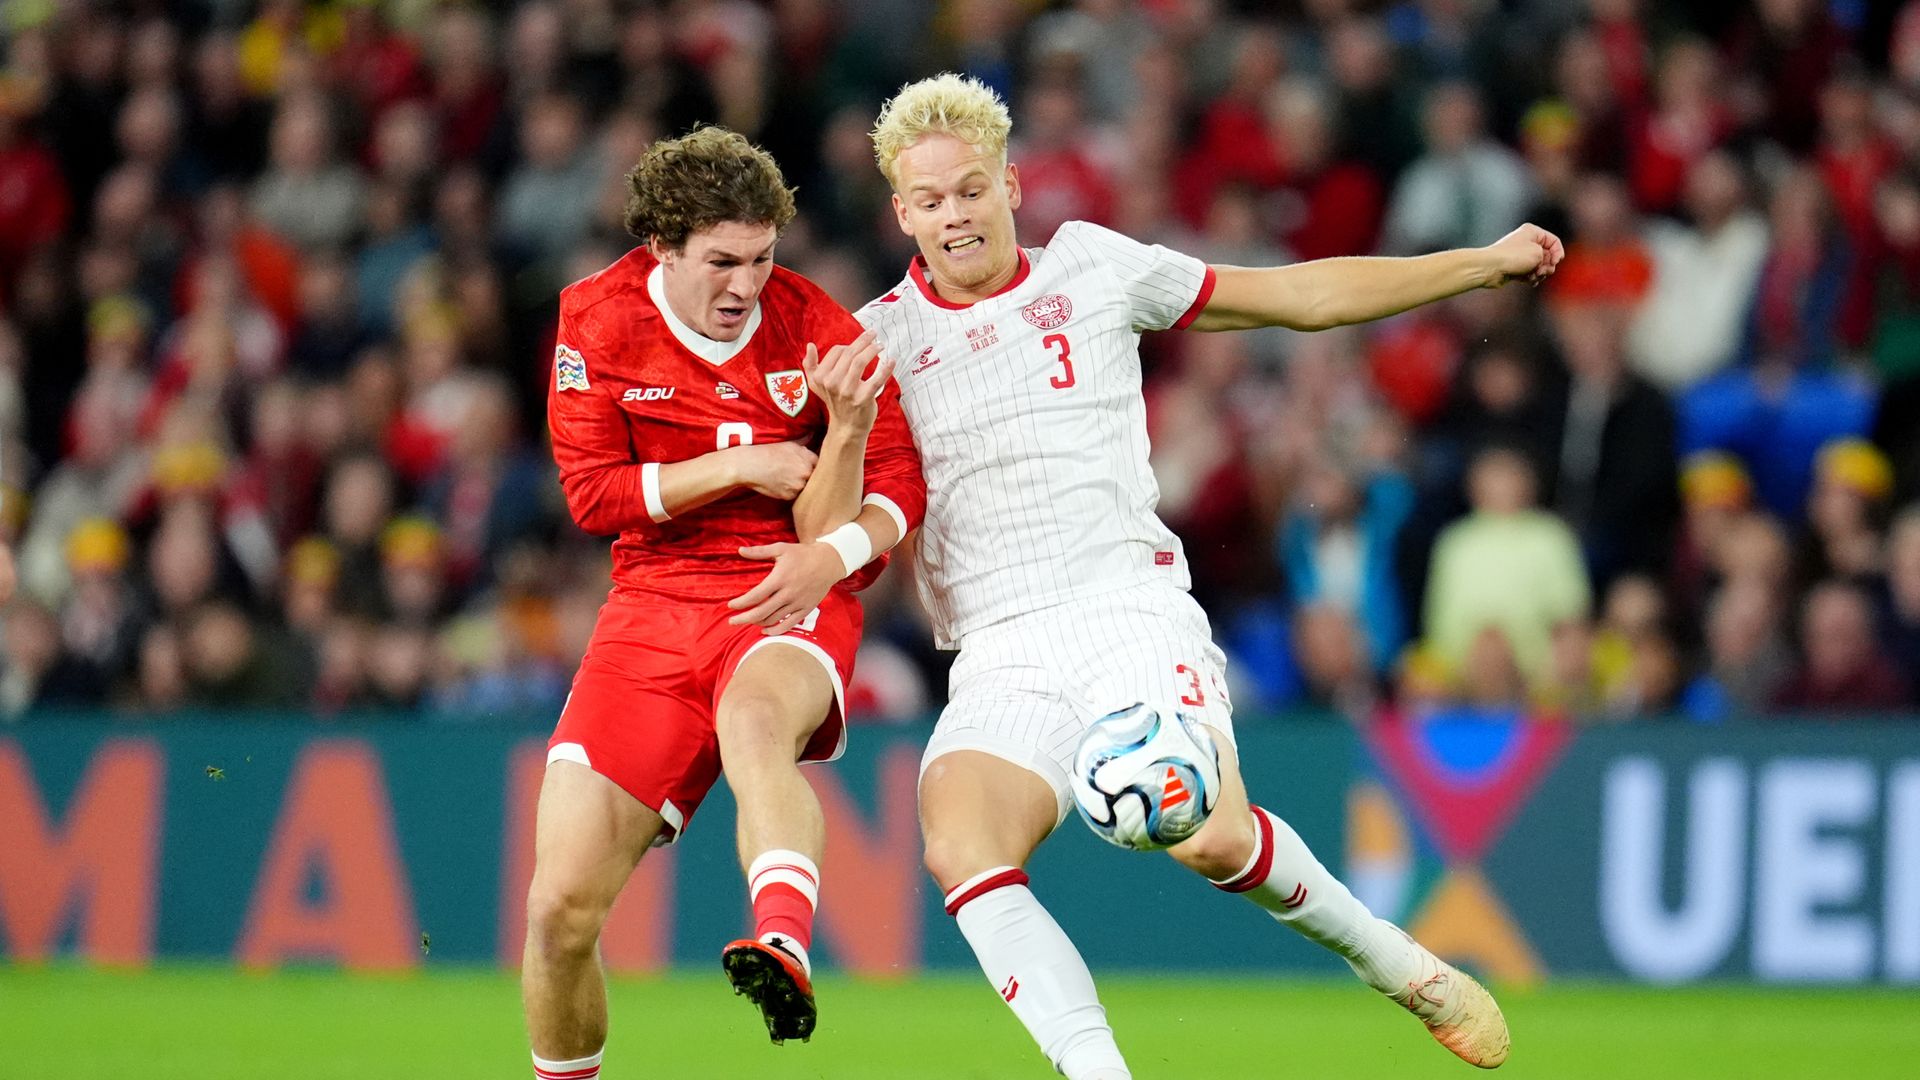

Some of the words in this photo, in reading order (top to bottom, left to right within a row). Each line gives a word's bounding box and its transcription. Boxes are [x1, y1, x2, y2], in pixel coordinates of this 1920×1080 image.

[912, 357, 940, 375] hummel
[1042, 333, 1076, 390] 3
[622, 387, 676, 402] SUDU
[1176, 664, 1205, 707] 3
